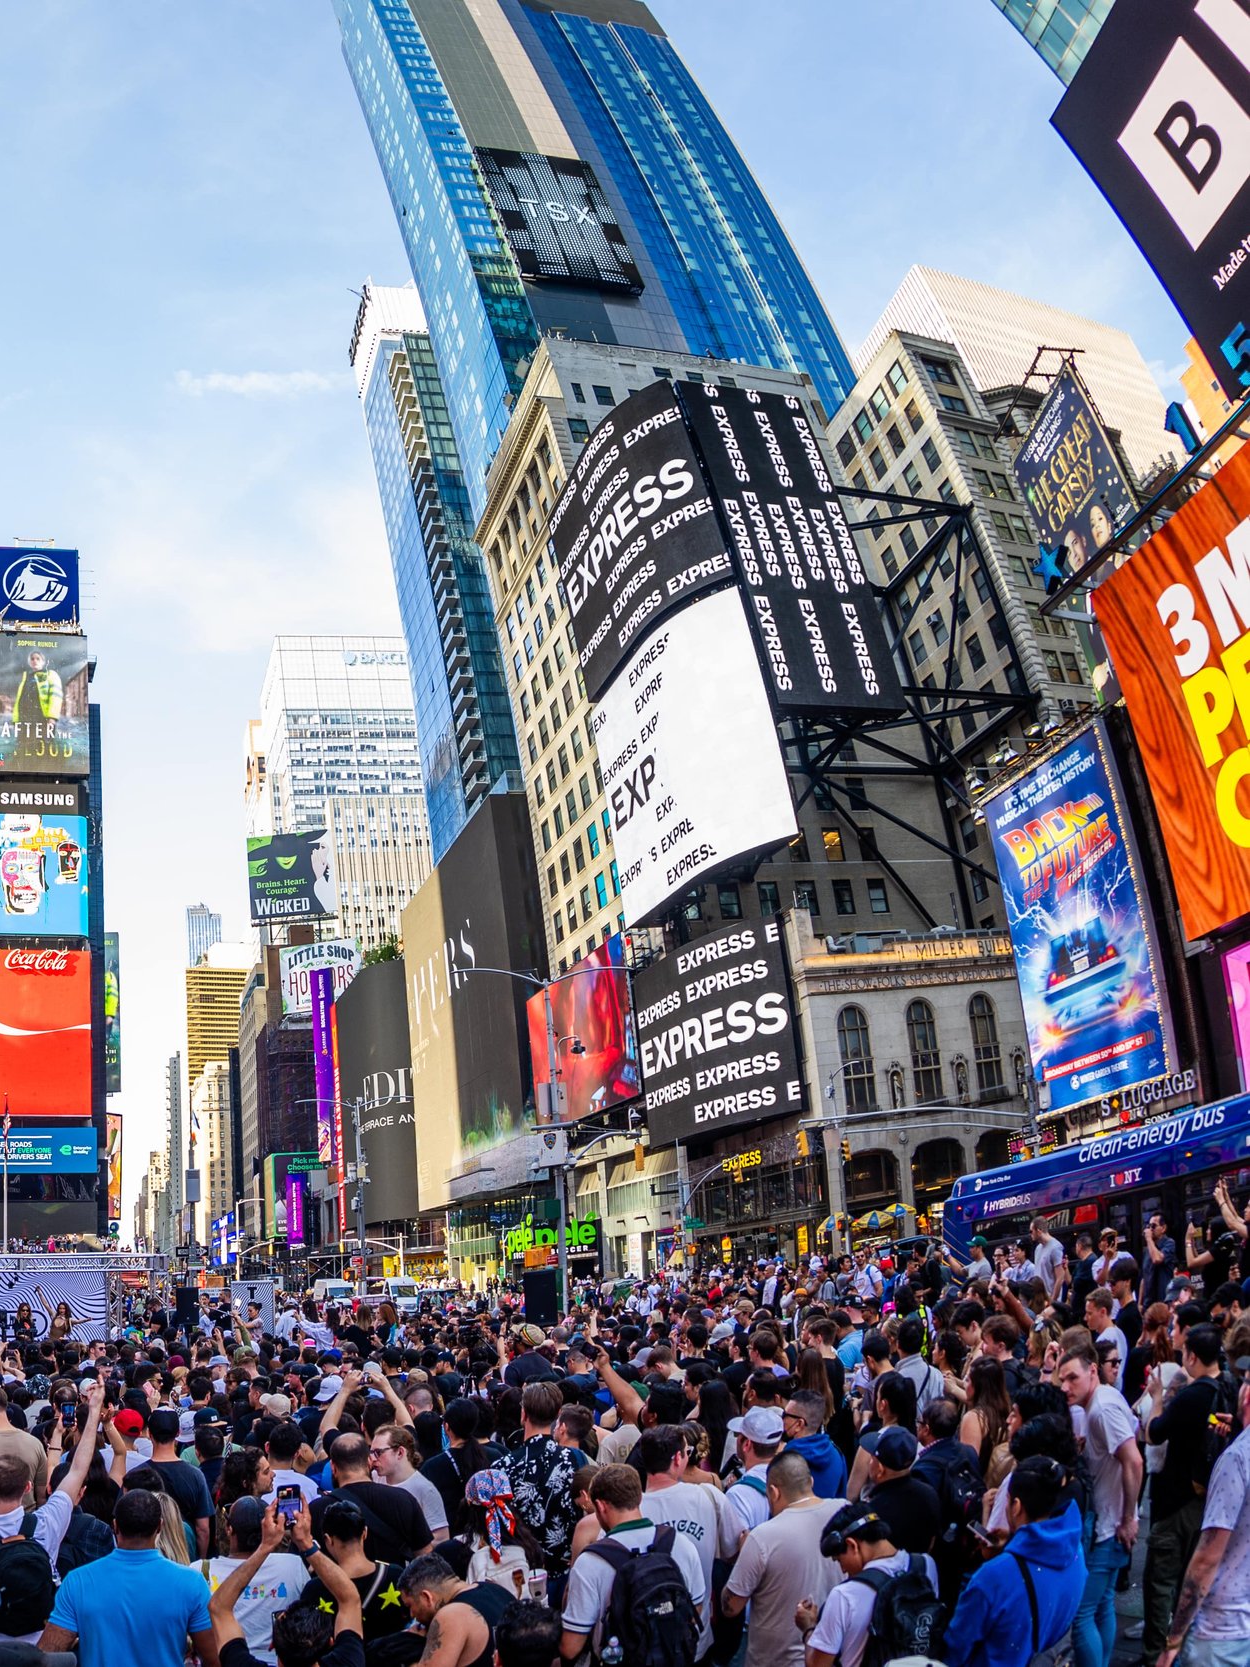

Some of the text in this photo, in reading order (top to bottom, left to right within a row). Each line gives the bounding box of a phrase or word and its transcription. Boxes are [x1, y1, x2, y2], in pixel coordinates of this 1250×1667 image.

[1154, 100, 1222, 195] B
[518, 198, 596, 226] TSX
[1213, 248, 1247, 291] Made
[1035, 390, 1066, 443] BEWITCHING
[710, 404, 750, 483] EXPRESS
[792, 416, 832, 494] EXPRESS
[1051, 408, 1093, 485] GREAT
[549, 421, 615, 536] EXPRESS EXPRESS
[1031, 469, 1051, 517] THE
[1048, 446, 1095, 533] GATSBY
[565, 458, 694, 618] EXPRESS
[723, 498, 763, 586] EXPRESS
[825, 500, 865, 585] EXPRESS
[580, 613, 612, 668] EXPRESS
[618, 589, 662, 648] EXPRESS
[753, 595, 793, 691] EXPRESS
[1156, 583, 1211, 677] 3
[17, 639, 58, 649] SOPHIE RUNDLE
[841, 602, 879, 696] EXPRESS
[1, 721, 73, 740] AFTER THE
[603, 738, 638, 787] EXPRESS
[1004, 750, 1081, 810] IT'S TIME TO CHANGE
[0, 792, 75, 807] SAMSUNG
[996, 752, 1097, 830] MUSICAL THEATER HISTORY
[1002, 801, 1090, 870] BACK
[1020, 813, 1112, 893] TO FUTURE
[256, 878, 308, 889] Brains. Heart.
[1066, 839, 1115, 889] THE MUSICAL
[265, 886, 299, 896] Courage.
[4, 948, 70, 971] Coca-Cola
[288, 944, 355, 969] LITTLE SHOP
[677, 930, 756, 975] EXPRESS
[915, 941, 966, 958] MILLER
[638, 959, 769, 1030] EXPRESS EXPRESS
[876, 974, 906, 988] FOLKS
[909, 972, 934, 985] SHOE
[936, 970, 960, 983] SHOP
[962, 967, 1005, 981] DEDICATED
[640, 992, 788, 1079] EXPRESS
[696, 1051, 781, 1091] EXPRESS
[1044, 1060, 1073, 1079] BROADWAY
[1073, 1053, 1101, 1070] BETWEEN
[1121, 1069, 1196, 1111] LUGGAGE
[364, 1115, 394, 1133] TERRACE
[1078, 1104, 1226, 1163] clean-energy bus
[1144, 1112, 1171, 1126] SONY
[722, 1150, 761, 1172] EXPRESS
[989, 1193, 1031, 1212] HYBRIDBUS
[507, 1213, 533, 1260] pelé
[550, 1245, 589, 1255] SCCER
